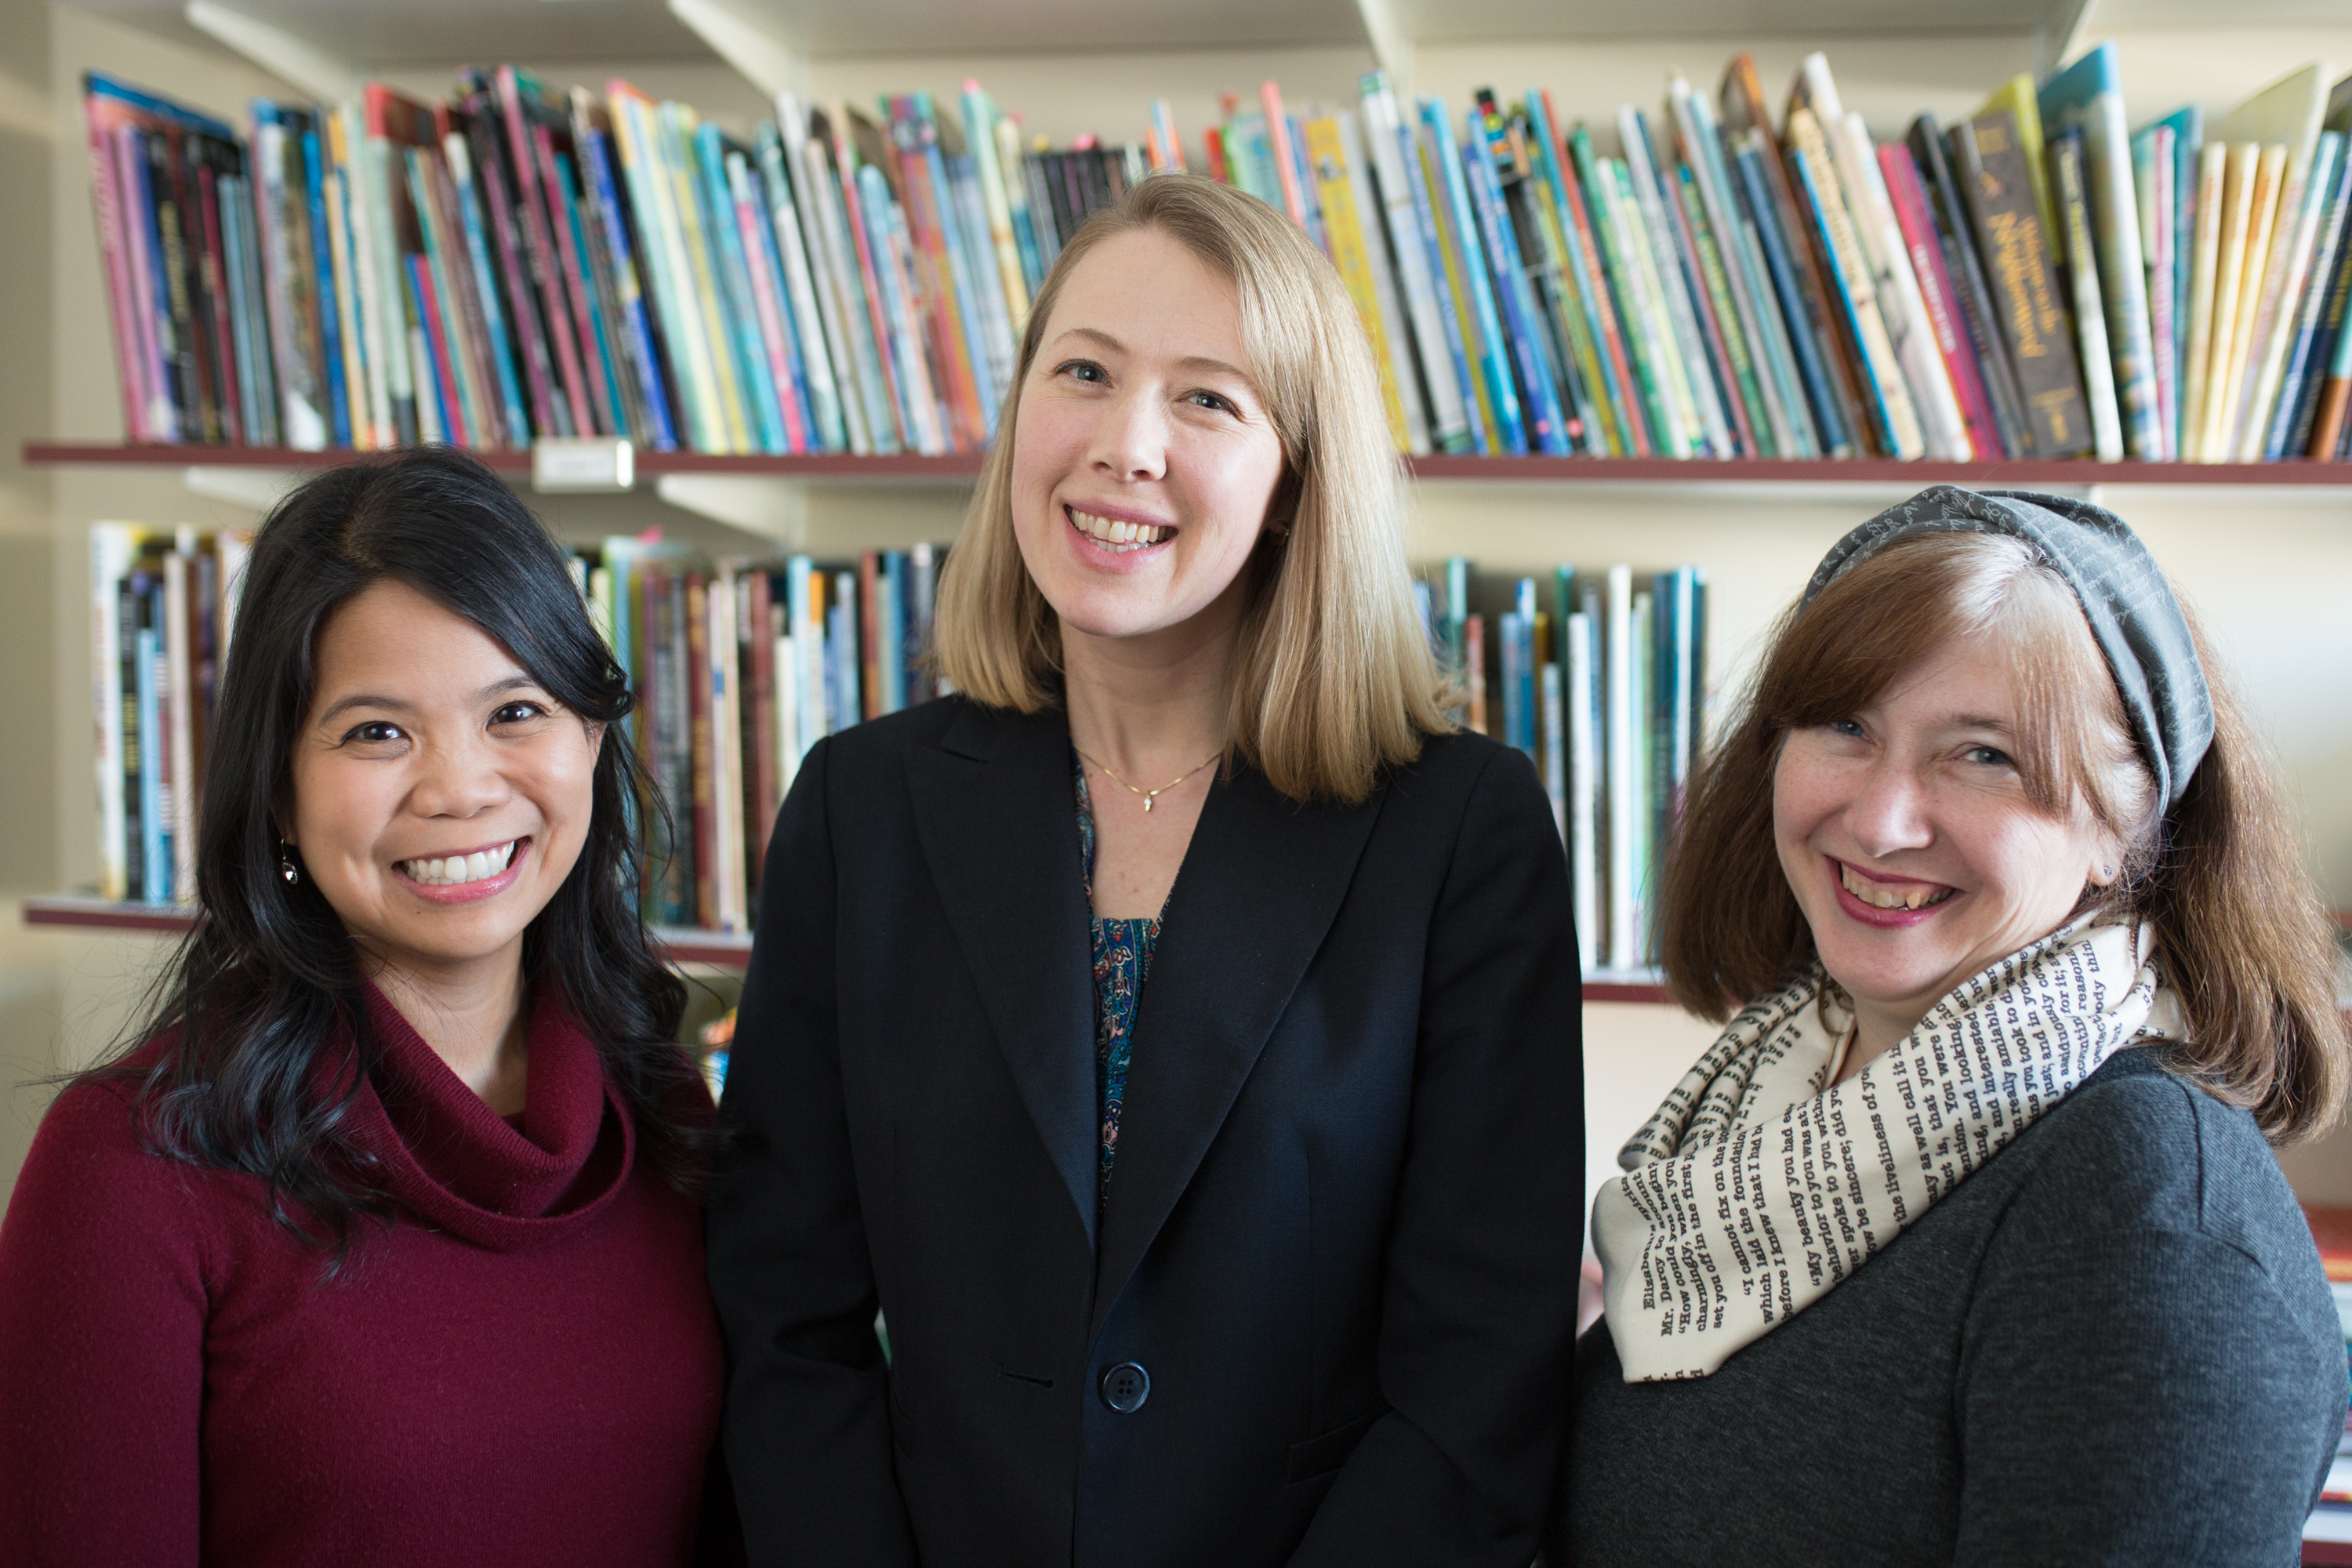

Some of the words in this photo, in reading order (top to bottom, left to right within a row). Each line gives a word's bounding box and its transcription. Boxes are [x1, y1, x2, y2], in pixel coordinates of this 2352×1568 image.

[2082, 939, 2100, 973] thin
[2054, 969, 2068, 988] it;
[2065, 948, 2087, 1011] reasona
[2007, 1007, 2019, 1025] to
[2060, 990, 2071, 1014] for
[1984, 999, 2012, 1068] amiable,
[2027, 1010, 2041, 1027] in
[1930, 1034, 1949, 1077] were
[1947, 1018, 1973, 1085] looking,
[1964, 1011, 1996, 1094] interested
[2011, 1026, 2031, 1063] took
[2032, 1029, 2052, 1060] and
[1860, 1065, 1875, 1091] yo
[1893, 1061, 1907, 1076] it
[1915, 1055, 1935, 1088] you
[2024, 1065, 2038, 1092] you
[2041, 1062, 2060, 1098] just;
[1861, 1093, 1878, 1110] of
[1896, 1078, 1916, 1110] call
[1942, 1080, 1958, 1114] You
[1963, 1088, 1982, 1120] and
[2002, 1071, 2021, 1116] really
[1797, 1110, 1809, 1127] at
[1813, 1094, 1828, 1138] witho
[1831, 1109, 1847, 1138] did
[1922, 1094, 1943, 1131] that
[1987, 1097, 2003, 1128] and
[1781, 1126, 1793, 1154] had
[1802, 1129, 1813, 1160] was
[1906, 1112, 1927, 1151] well
[1935, 1137, 1951, 1156] is,
[1954, 1117, 1973, 1173] ention.
[1712, 1145, 1726, 1167] the
[1748, 1137, 1762, 1160] had
[1821, 1141, 1838, 1171] you
[1871, 1112, 1900, 1195] liveliness
[1919, 1152, 1932, 1171] as
[1665, 1160, 1678, 1189] you
[1681, 1163, 1694, 1200] first
[1715, 1170, 1726, 1191] on
[1730, 1131, 1747, 1202] foundatio
[1748, 1163, 1760, 1171] I
[1784, 1156, 1800, 1187] you
[1803, 1159, 1822, 1192] you
[1840, 1139, 1864, 1205] sincere;
[1647, 1161, 1669, 1211] begin?
[1749, 1174, 1766, 1210] that
[1826, 1175, 1839, 1193] to
[1632, 1171, 1665, 1229] account
[1670, 1191, 1687, 1236] when
[1718, 1195, 1731, 1220] fix
[1810, 1192, 1824, 1210] to
[1893, 1195, 1907, 1222] the
[1666, 1213, 1677, 1243] you
[1688, 1203, 1701, 1230] the
[1739, 1207, 1755, 1235] the
[1789, 1190, 1813, 1247] beauty
[1832, 1196, 1855, 1243] spoke
[1857, 1207, 1871, 1229] be
[1654, 1235, 1664, 1250] to
[1694, 1232, 1708, 1250] in
[1723, 1224, 1751, 1274] cannot
[1759, 1213, 1783, 1255] knew
[1816, 1213, 1844, 1283] behavior
[1665, 1246, 1686, 1287] could
[1697, 1252, 1716, 1272] off
[1747, 1238, 1768, 1268] laid
[1773, 1258, 1786, 1267] I
[1655, 1255, 1673, 1303] Darcy
[1682, 1240, 1708, 1331] charmingly,
[1711, 1273, 1727, 1303] you
[1759, 1272, 1774, 1324] which
[1779, 1269, 1793, 1321] before
[1661, 1308, 1675, 1337] Mr.
[1713, 1305, 1724, 1329] set
